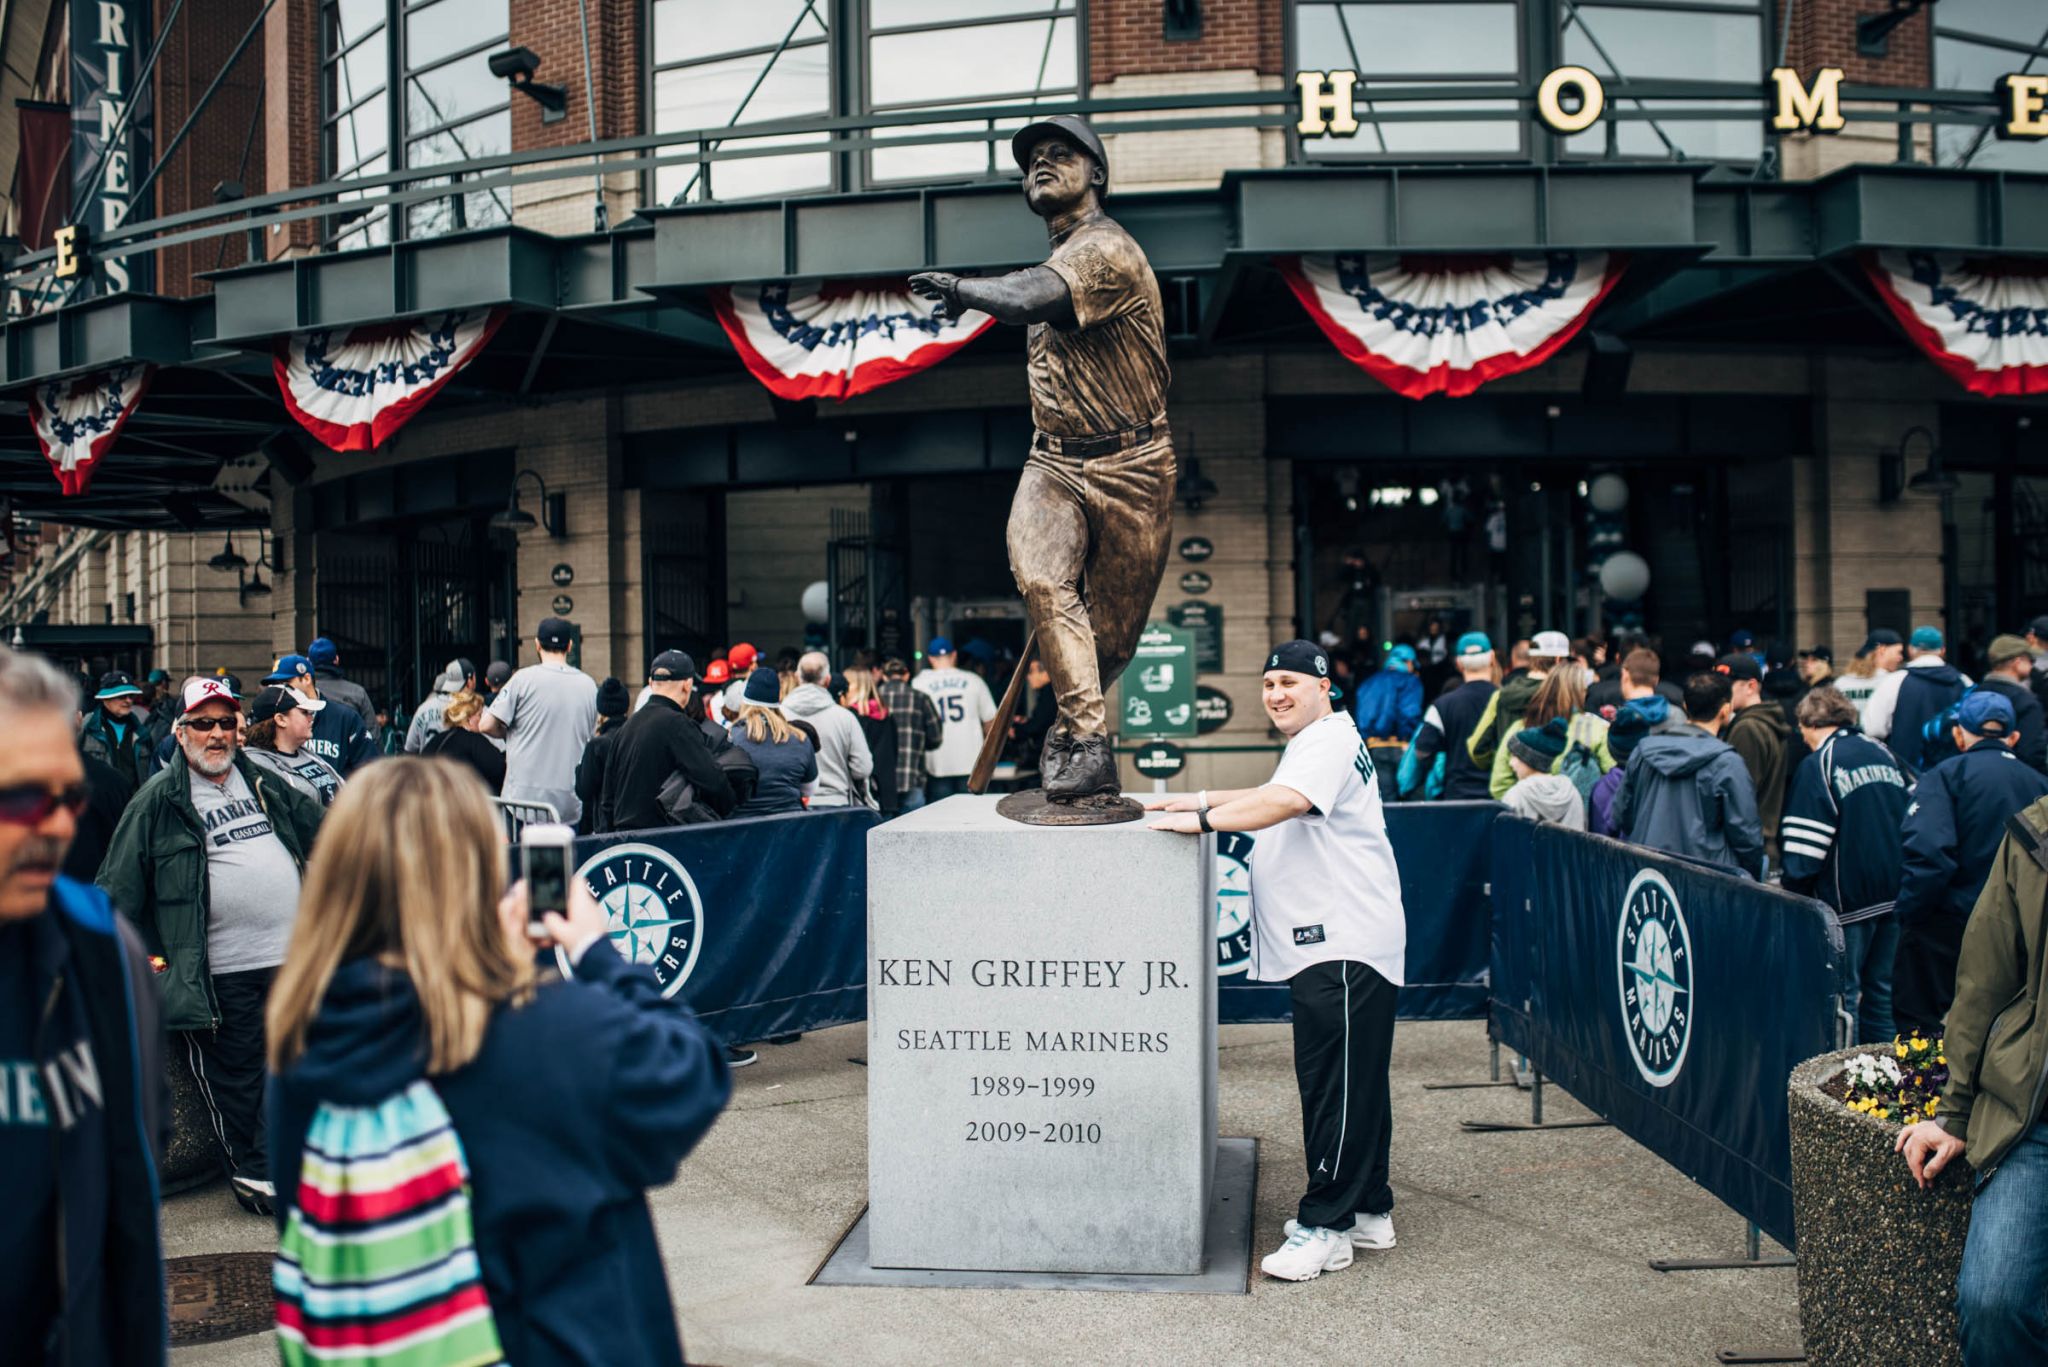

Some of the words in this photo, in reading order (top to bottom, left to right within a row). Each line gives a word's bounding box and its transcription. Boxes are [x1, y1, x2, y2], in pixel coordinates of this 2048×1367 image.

[1271, 654, 1279, 667] S
[937, 694, 965, 724] 15
[232, 824, 271, 839] BASEBALL
[586, 860, 683, 905] EATTLE
[1626, 889, 1685, 963] SEATTLE
[878, 959, 952, 987] KEN
[971, 959, 1126, 989] GRIFFEY
[1139, 961, 1189, 996] JR.
[898, 1029, 1012, 1051] SEATTLE
[1026, 1031, 1169, 1053] MARINERS
[970, 1076, 1096, 1097] 1989-1999
[965, 1121, 1101, 1144] 2009-2010
